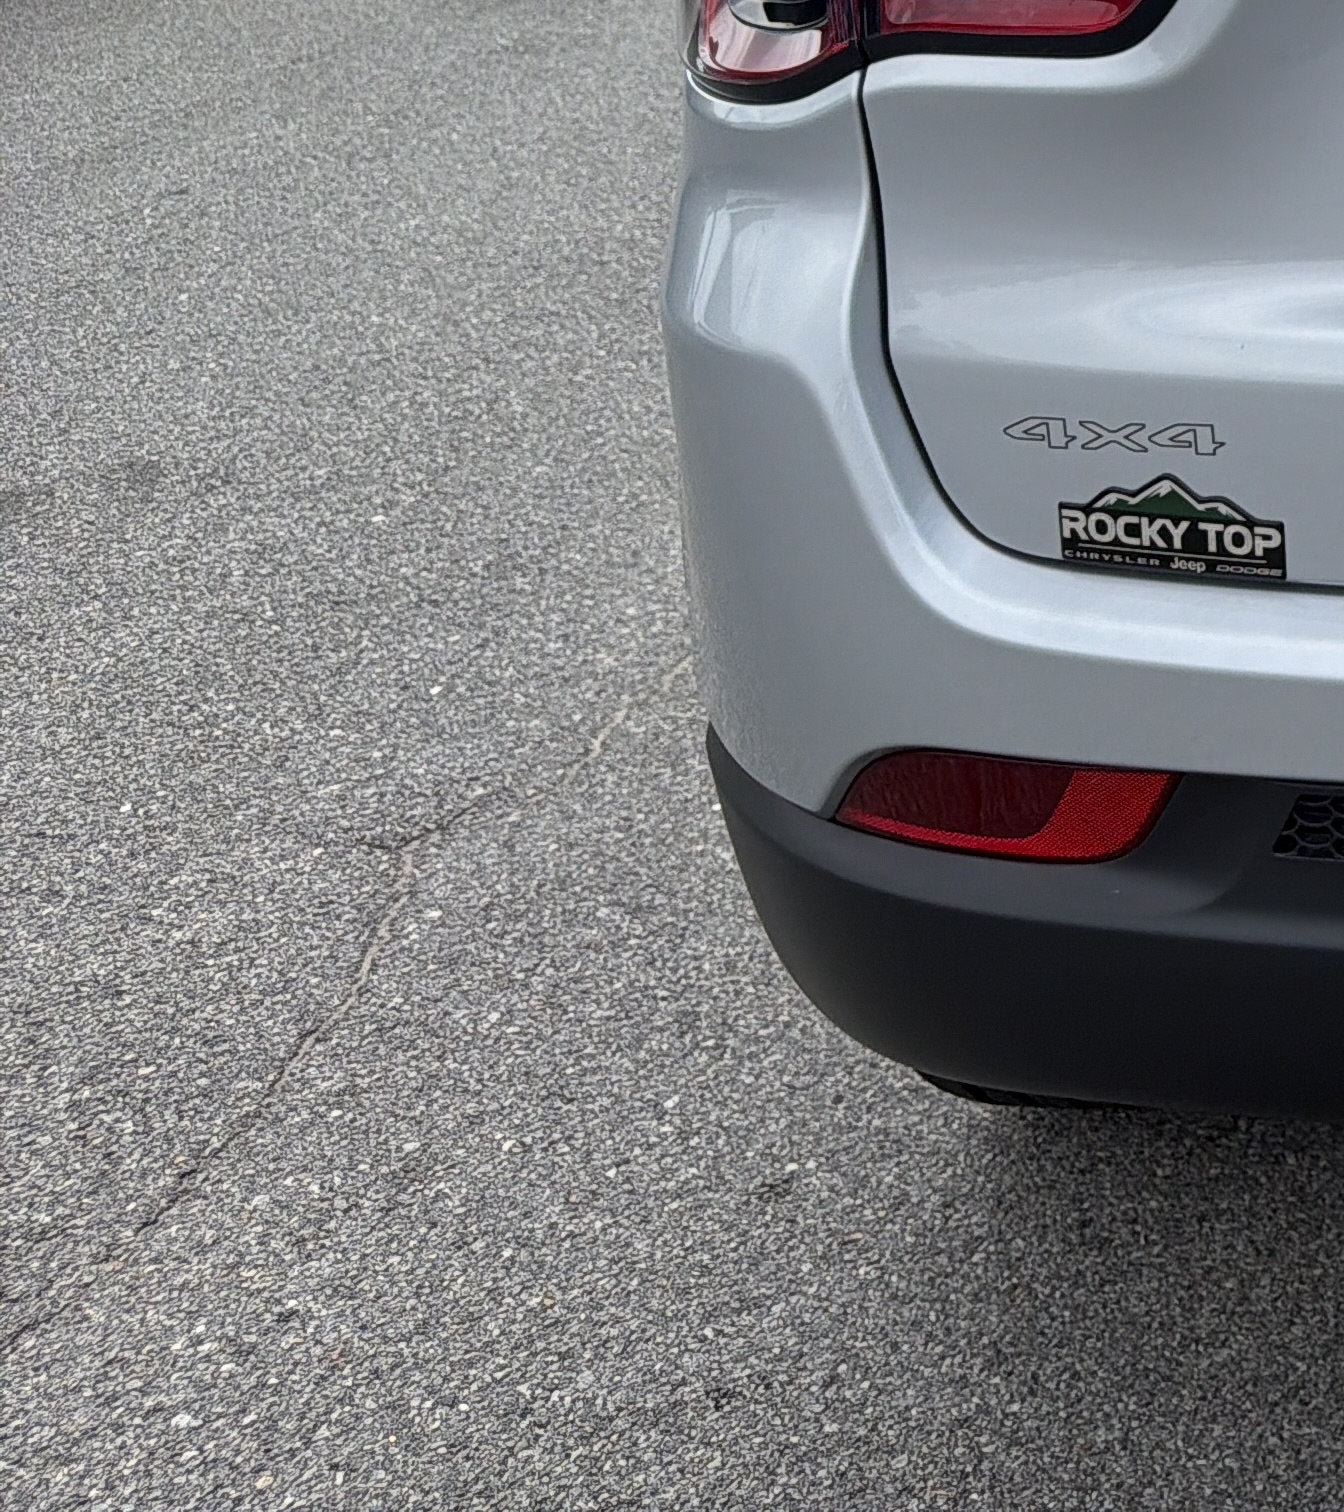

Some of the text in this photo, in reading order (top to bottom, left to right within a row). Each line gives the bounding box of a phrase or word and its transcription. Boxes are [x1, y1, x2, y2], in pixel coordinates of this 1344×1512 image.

[1061, 509, 1283, 557] ROCKY TOP
[1064, 550, 1283, 577] CHRYSLER Jeep DODGE
